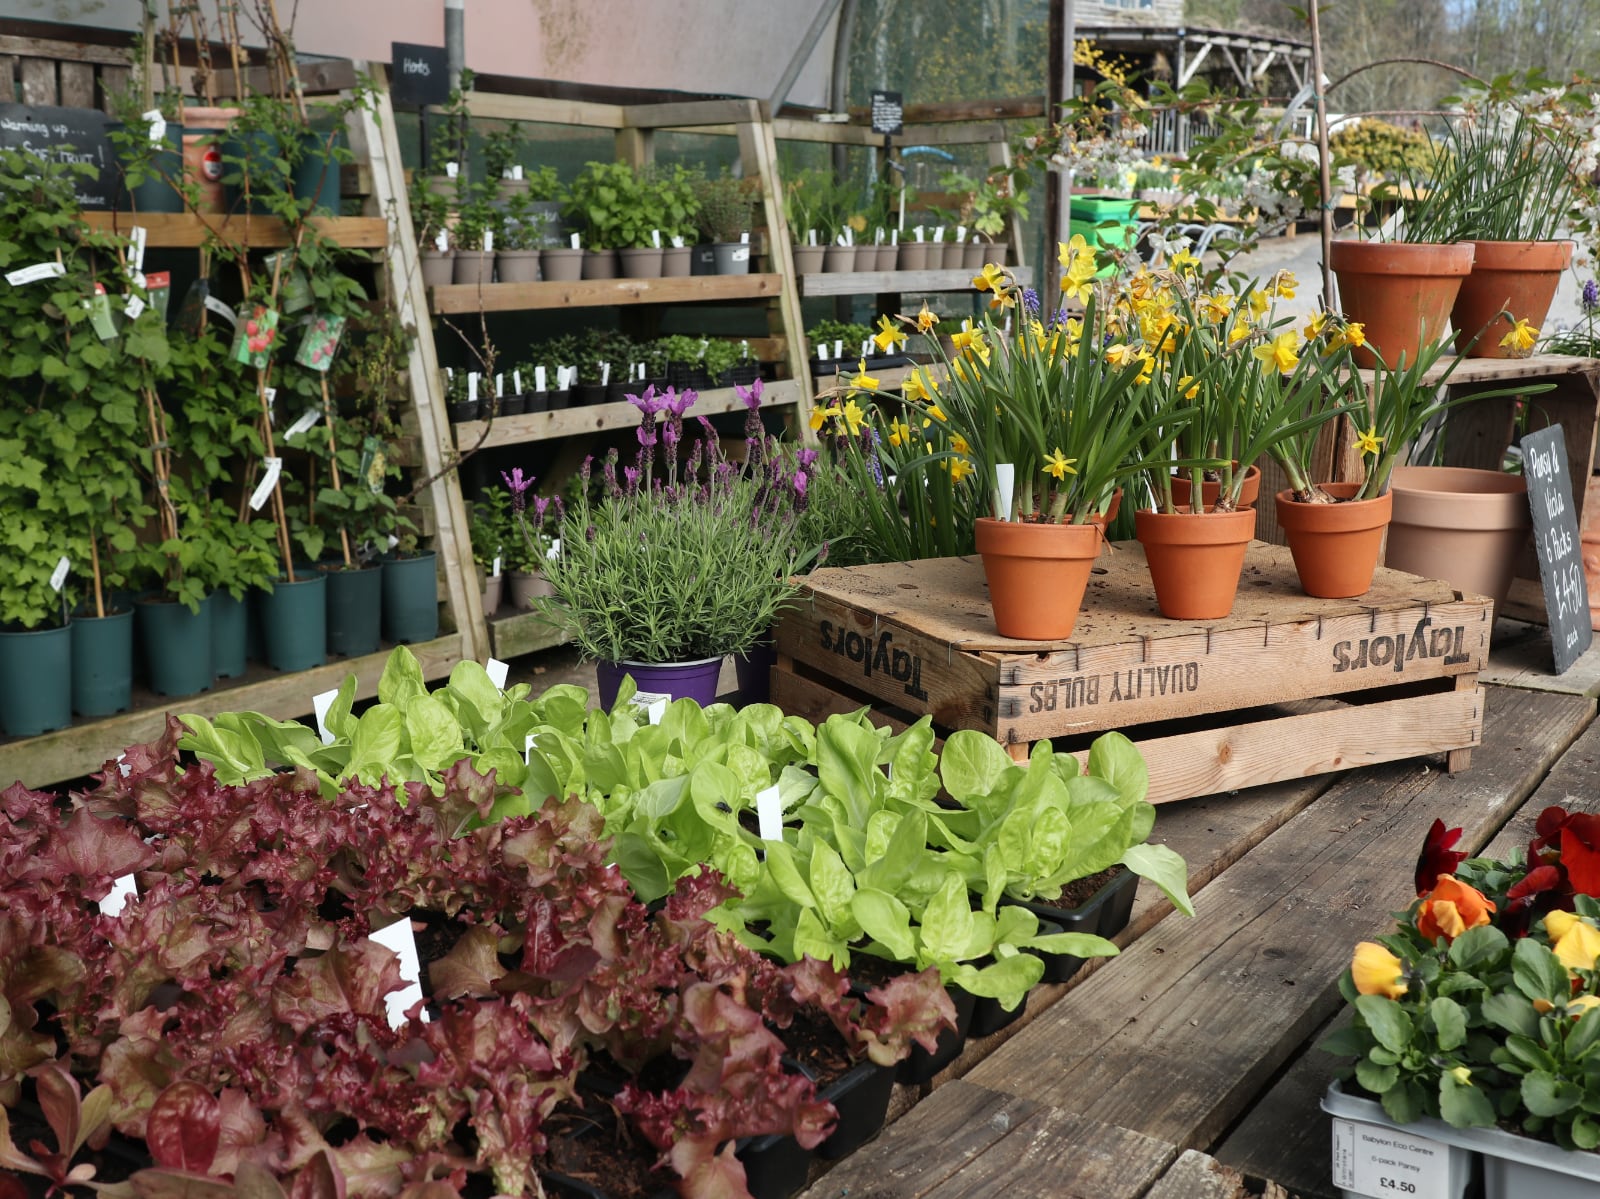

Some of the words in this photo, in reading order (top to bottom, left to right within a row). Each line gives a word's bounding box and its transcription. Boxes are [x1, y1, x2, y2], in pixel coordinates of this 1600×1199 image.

[403, 57, 431, 76] Herbs
[1530, 447, 1553, 483] Pansy
[1551, 441, 1560, 474] &
[1544, 487, 1565, 521] Viola
[1544, 533, 1553, 564] 6
[1550, 524, 1572, 561] Packs
[820, 619, 929, 703] Taylors
[1332, 617, 1471, 673] Taylors
[1029, 674, 1100, 714] BULBS
[1109, 661, 1199, 703] QUALITY
[1362, 1133, 1392, 1147] Babylon
[1392, 1141, 1408, 1150] Eco
[1408, 1145, 1434, 1156] Centre
[1379, 1176, 1416, 1194] £4.50
